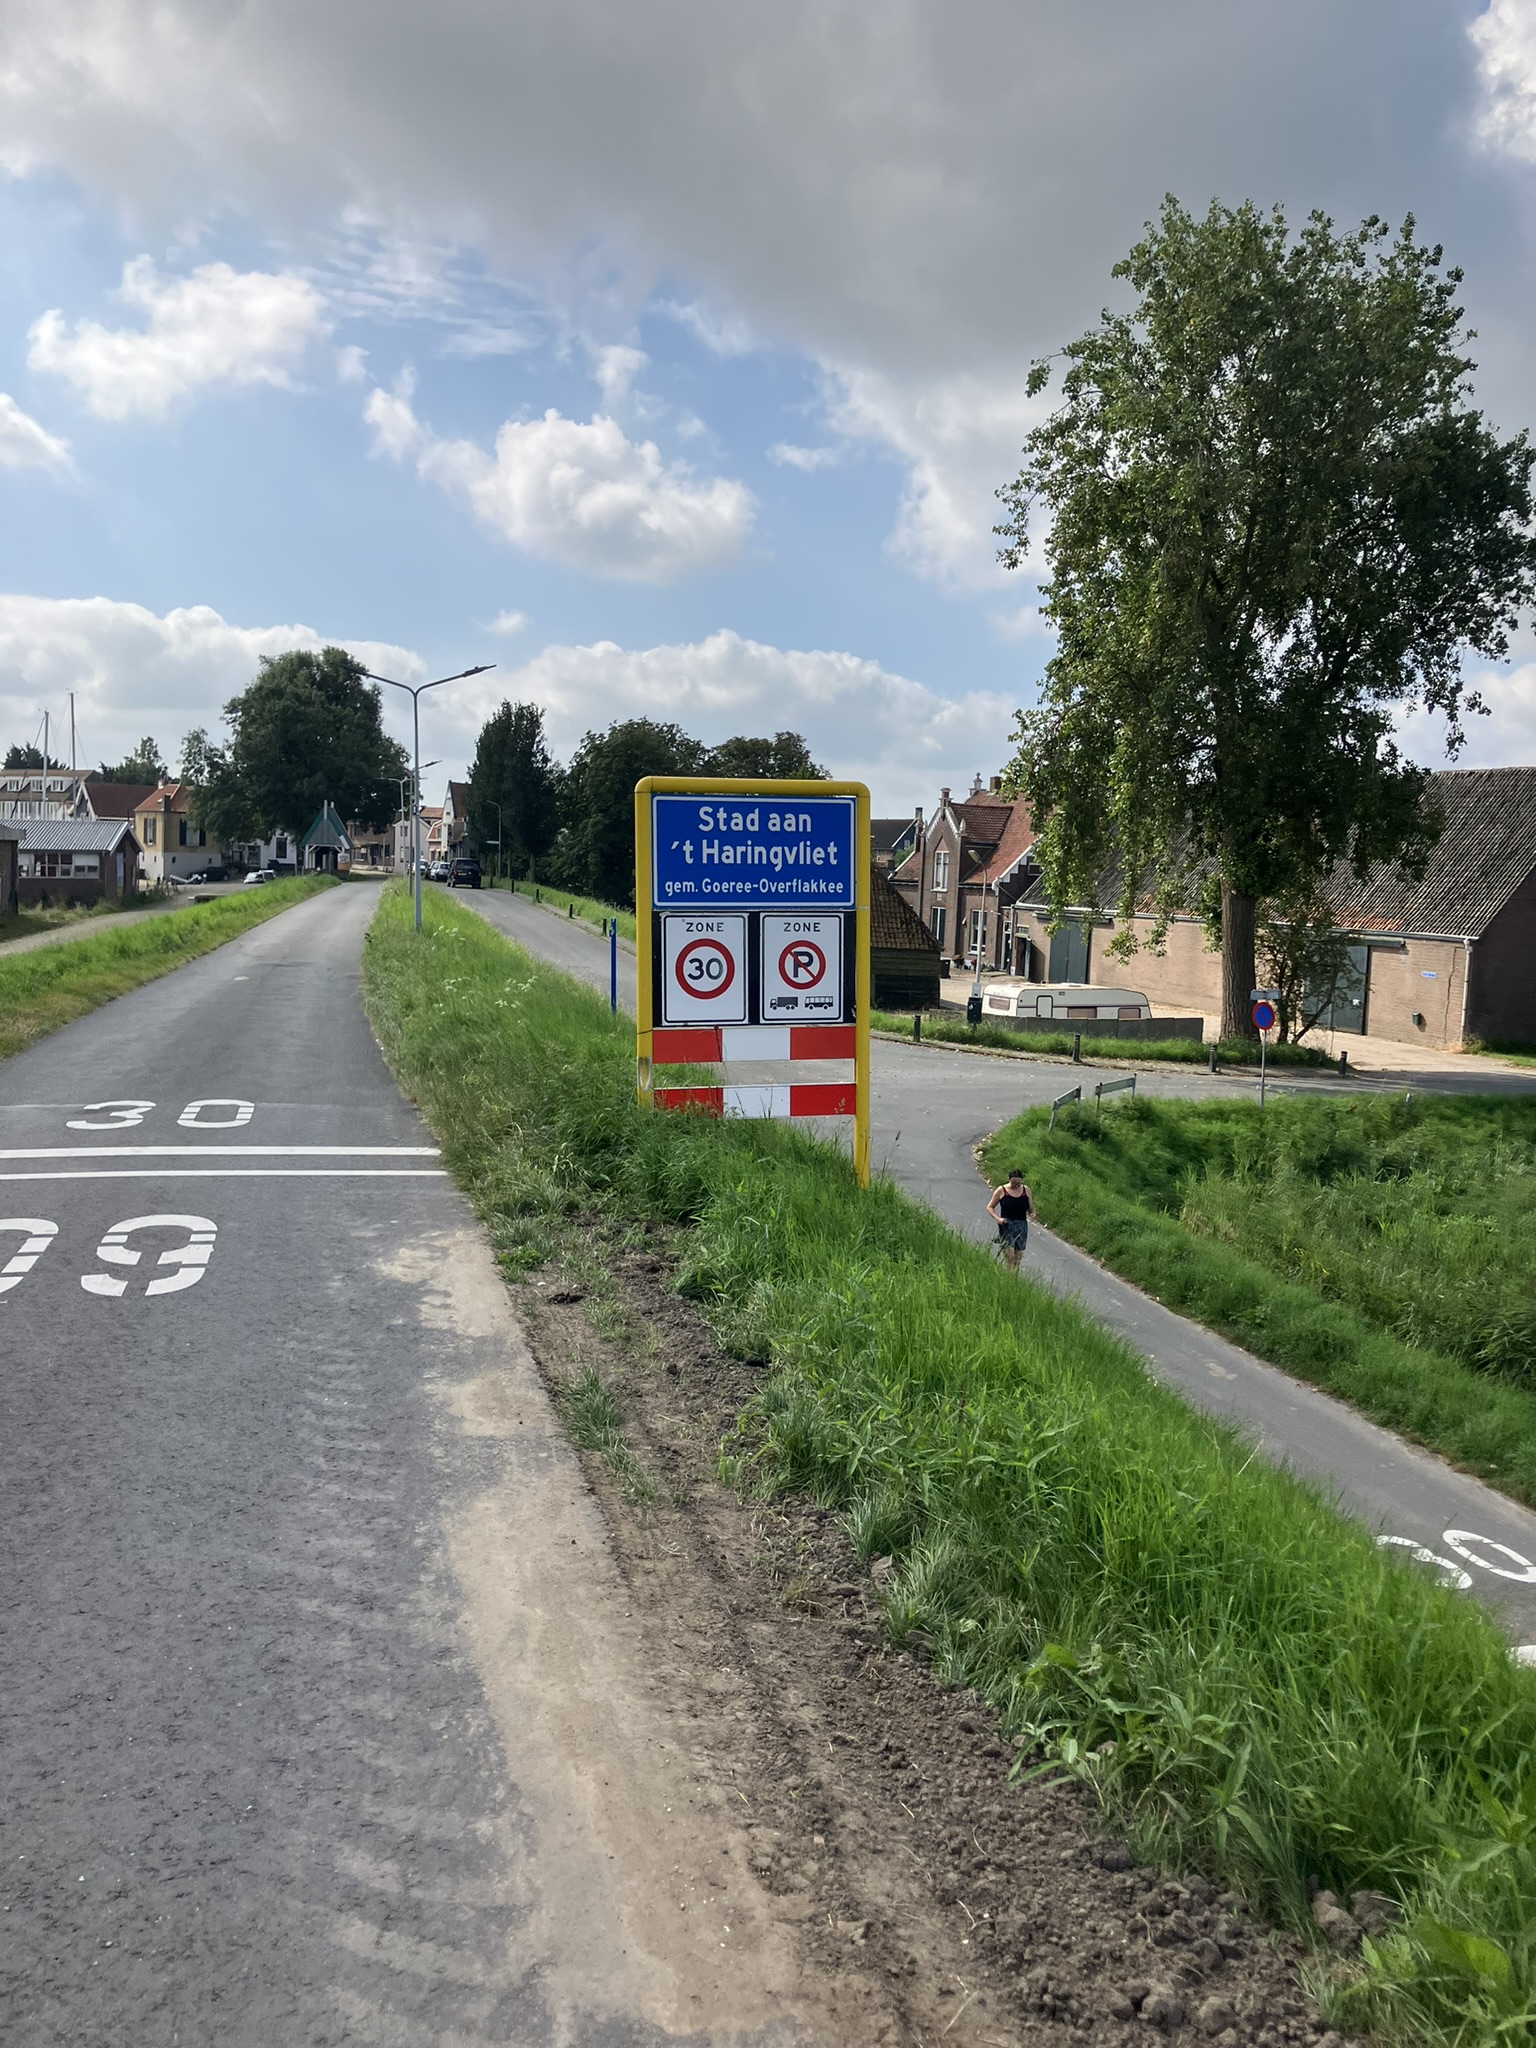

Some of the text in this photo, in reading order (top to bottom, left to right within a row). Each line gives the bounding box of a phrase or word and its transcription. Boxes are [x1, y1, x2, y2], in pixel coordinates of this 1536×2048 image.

[698, 806, 812, 832] Stad aan
[701, 839, 838, 872] Haringvliet
[664, 878, 844, 897] gem. Goeree-Overflakkee
[685, 922, 725, 933] ZONE
[783, 922, 821, 933] ZONE
[687, 957, 724, 981] 30
[66, 1099, 255, 1130] 30
